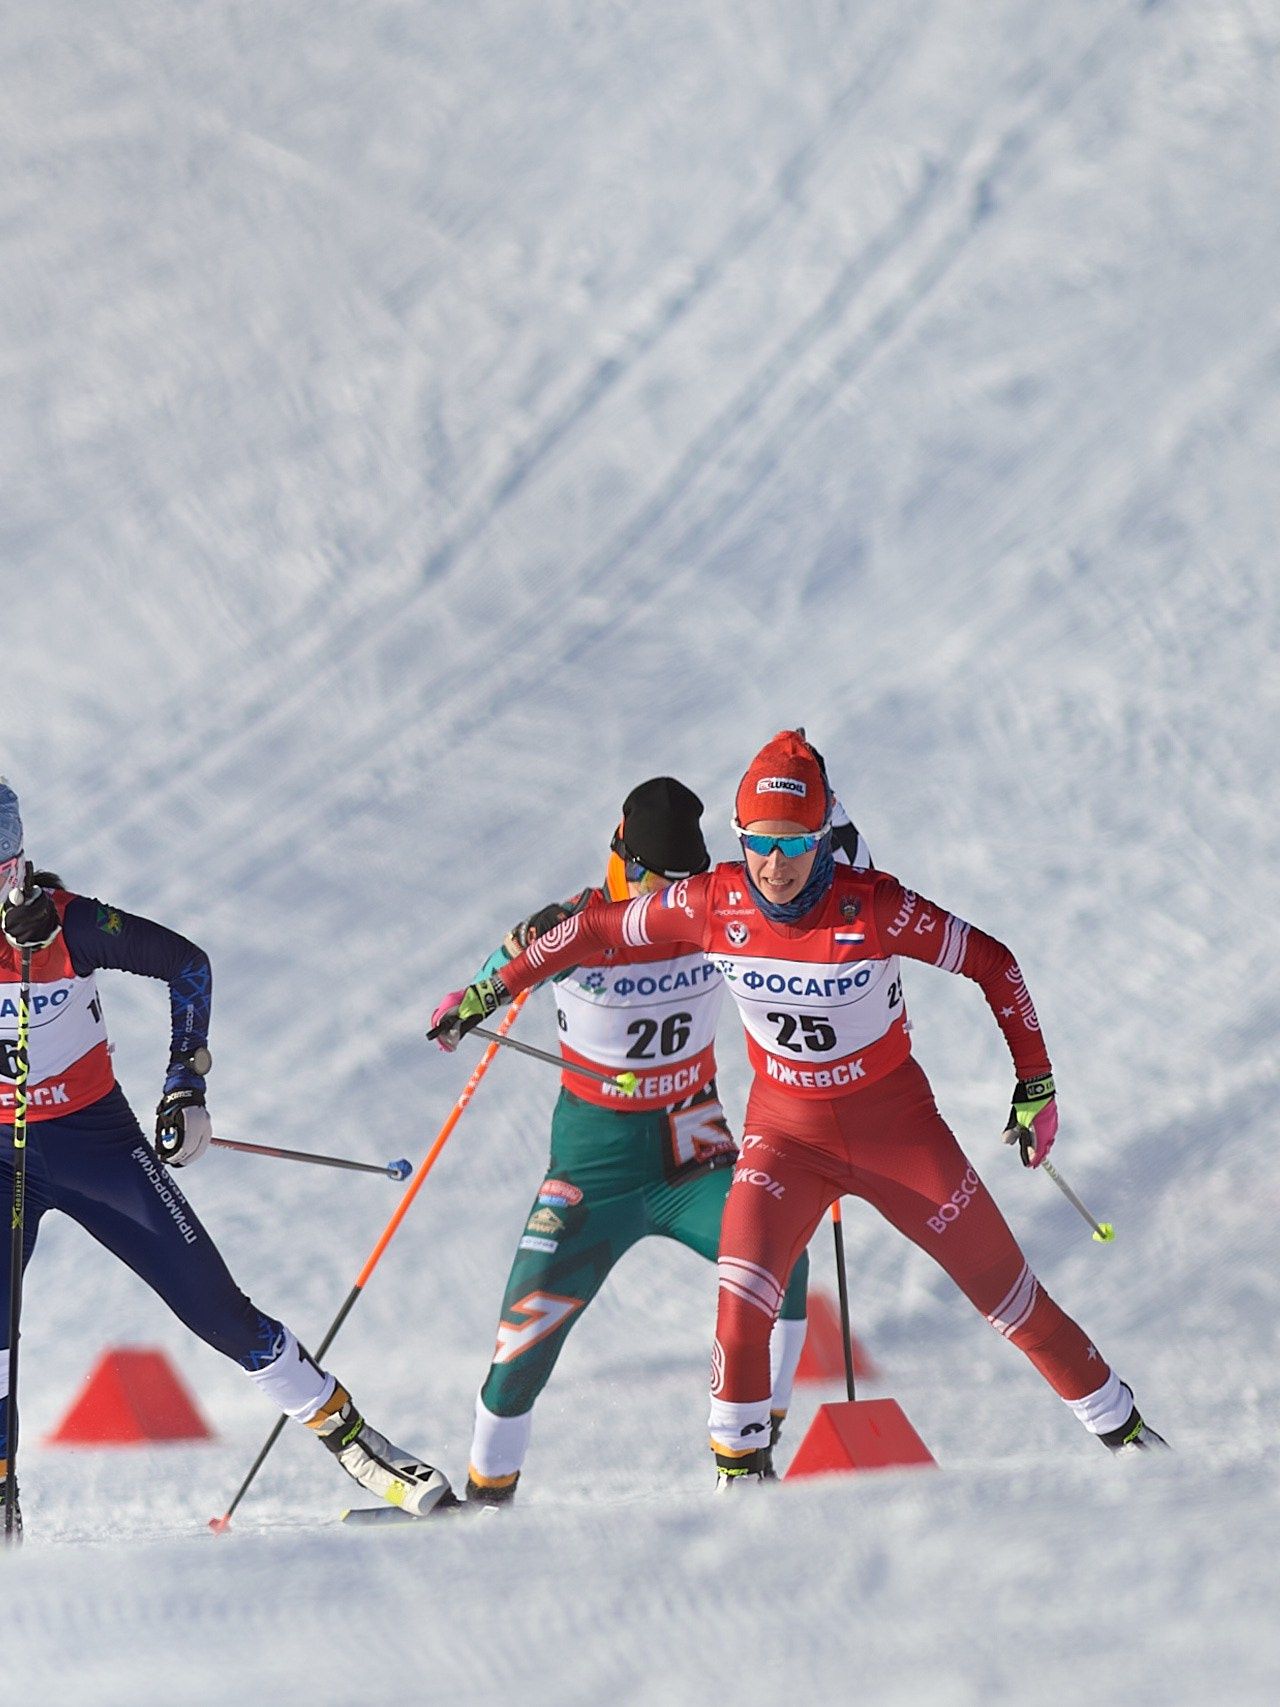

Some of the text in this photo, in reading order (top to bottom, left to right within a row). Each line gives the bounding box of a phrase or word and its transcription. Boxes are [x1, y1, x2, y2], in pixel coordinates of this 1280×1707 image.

[770, 781, 805, 794] LUKOIL
[613, 963, 721, 997] ФОСАГР
[742, 969, 872, 998] ФОСАГРО
[625, 1011, 693, 1060] 26
[765, 1011, 838, 1054] 25
[765, 1055, 867, 1089] ИЖЕВСК
[130, 1146, 198, 1244] ПРИМОРСКИЙ
[926, 1165, 980, 1235] BOSCO
